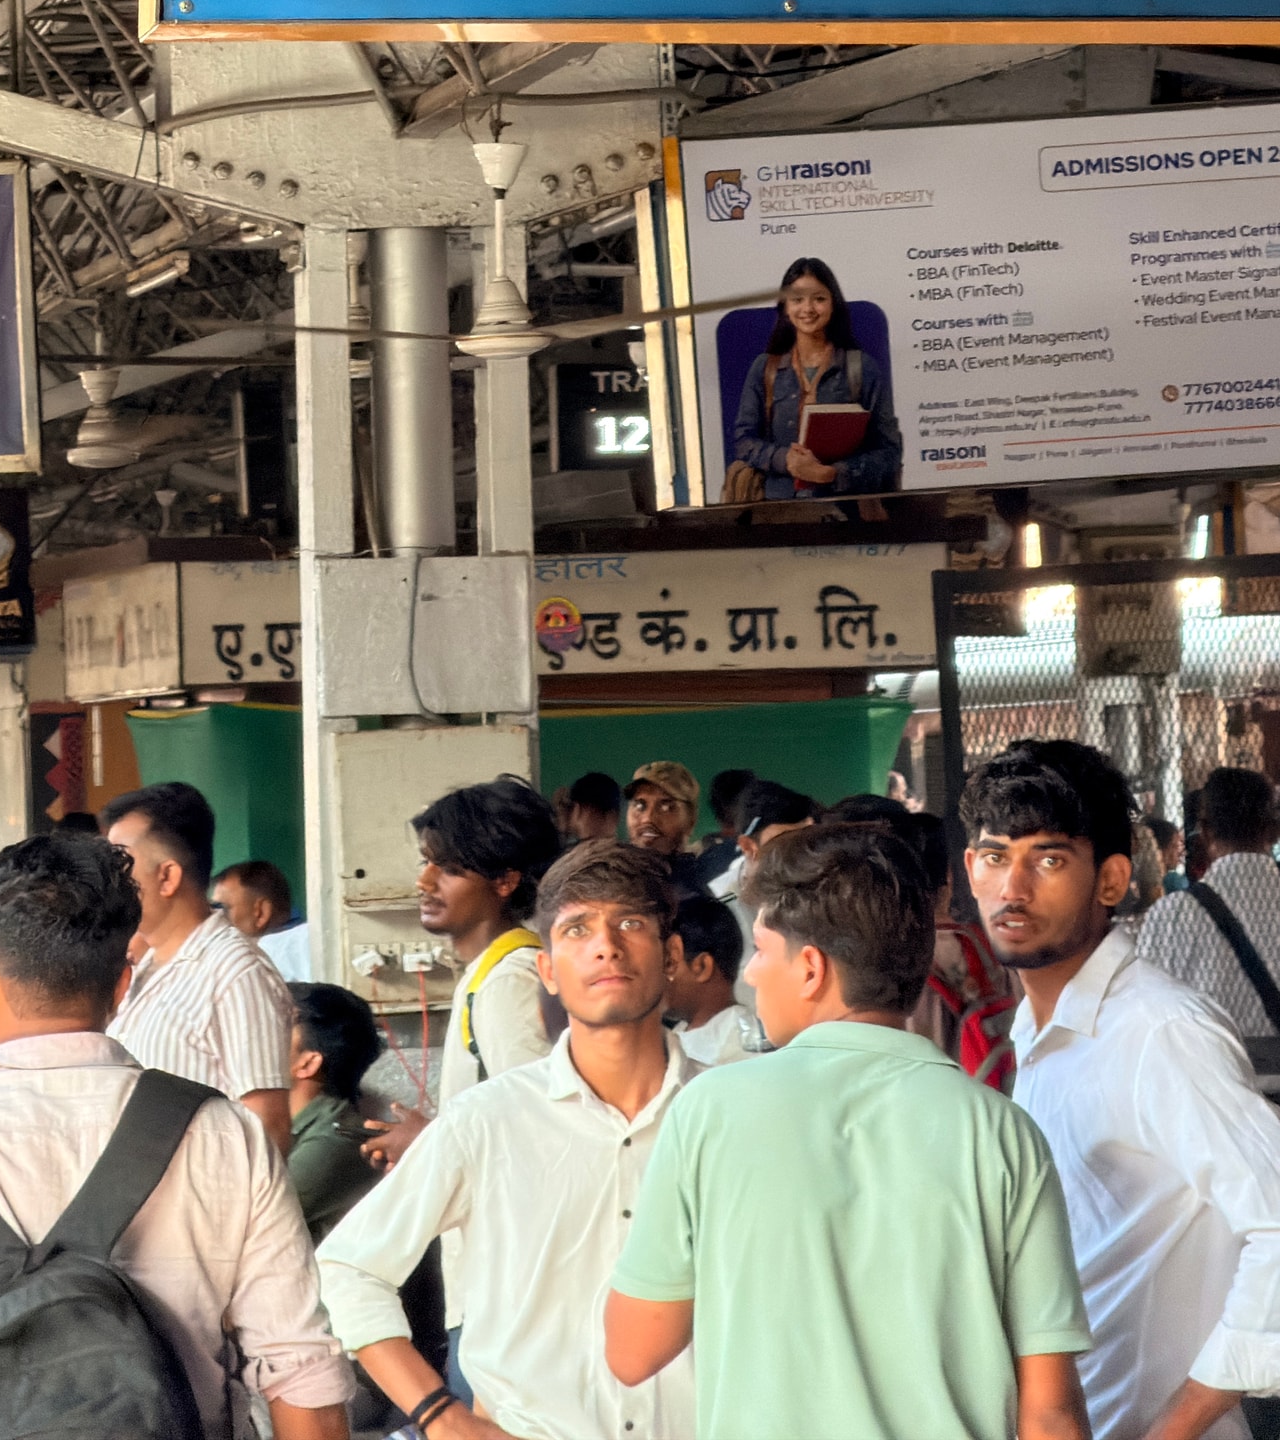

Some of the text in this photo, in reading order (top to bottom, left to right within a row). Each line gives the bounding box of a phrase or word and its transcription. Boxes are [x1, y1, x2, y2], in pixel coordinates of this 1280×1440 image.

[1050, 151, 1194, 179] ADMISSIONS
[1198, 145, 1264, 171] OPEN
[759, 179, 877, 198] INTERNATIONAL
[760, 222, 797, 235] Pune
[1129, 232, 1160, 245] Skill
[1163, 226, 1237, 243] Enhanced
[907, 247, 968, 260] Courses
[972, 242, 1004, 256] with
[1131, 248, 1227, 266] Programmes
[1230, 245, 1262, 258] with
[917, 262, 1020, 280] BBA (FinTech)
[1140, 273, 1182, 286] Event
[1185, 268, 1233, 282] Master
[919, 283, 1024, 301] MBA (FinTech)
[1142, 292, 1205, 307] Wedding
[1209, 288, 1249, 302] Event
[912, 319, 973, 331] Courses
[977, 314, 1008, 327] with
[1143, 313, 1197, 327] Festival
[1201, 309, 1241, 324] Event
[922, 327, 1109, 351] BBA (Event Management)
[923, 348, 1114, 372] MBA (Event Management)
